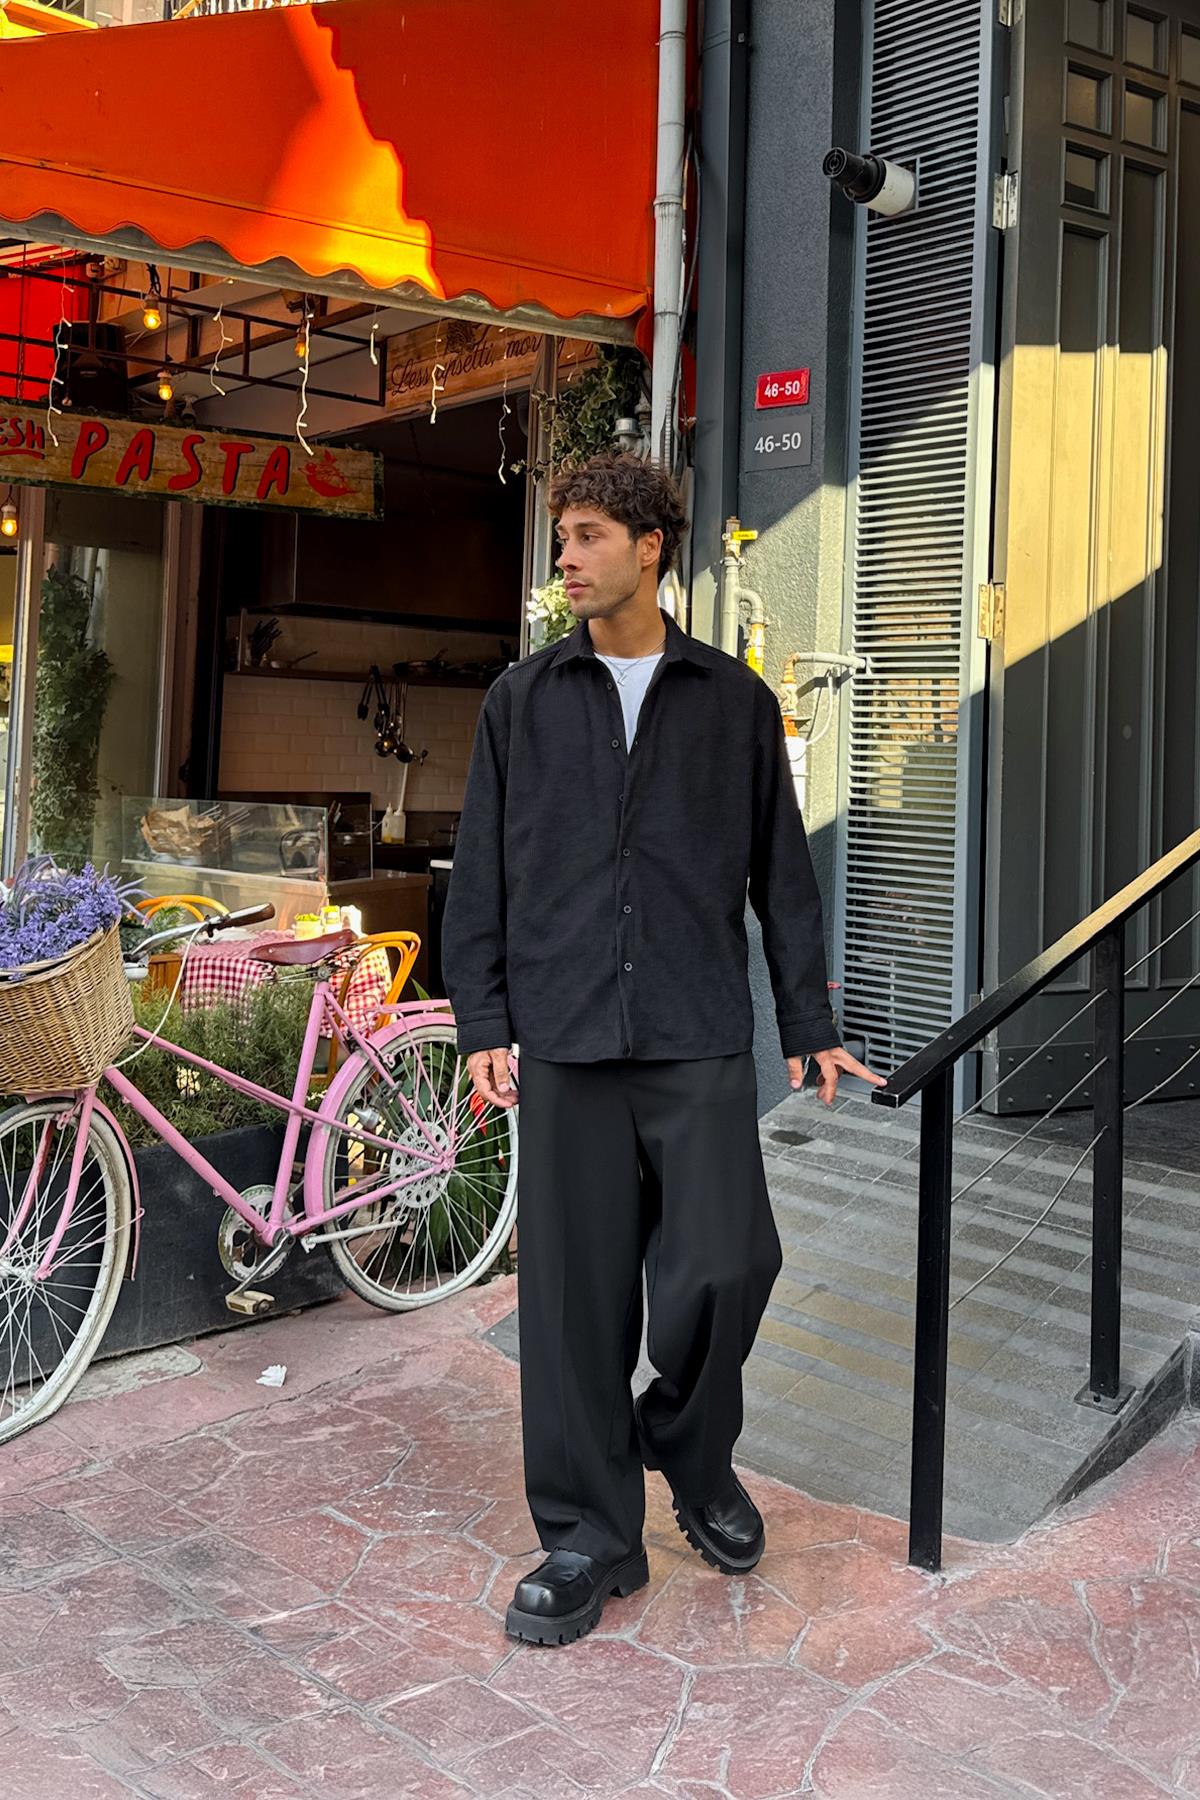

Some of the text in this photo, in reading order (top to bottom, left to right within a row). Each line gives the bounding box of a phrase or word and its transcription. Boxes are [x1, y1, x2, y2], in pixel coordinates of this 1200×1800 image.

[391, 358, 429, 396] Less
[764, 380, 801, 398] 46-50
[754, 432, 802, 454] 46-50
[70, 421, 291, 500] PASTA
